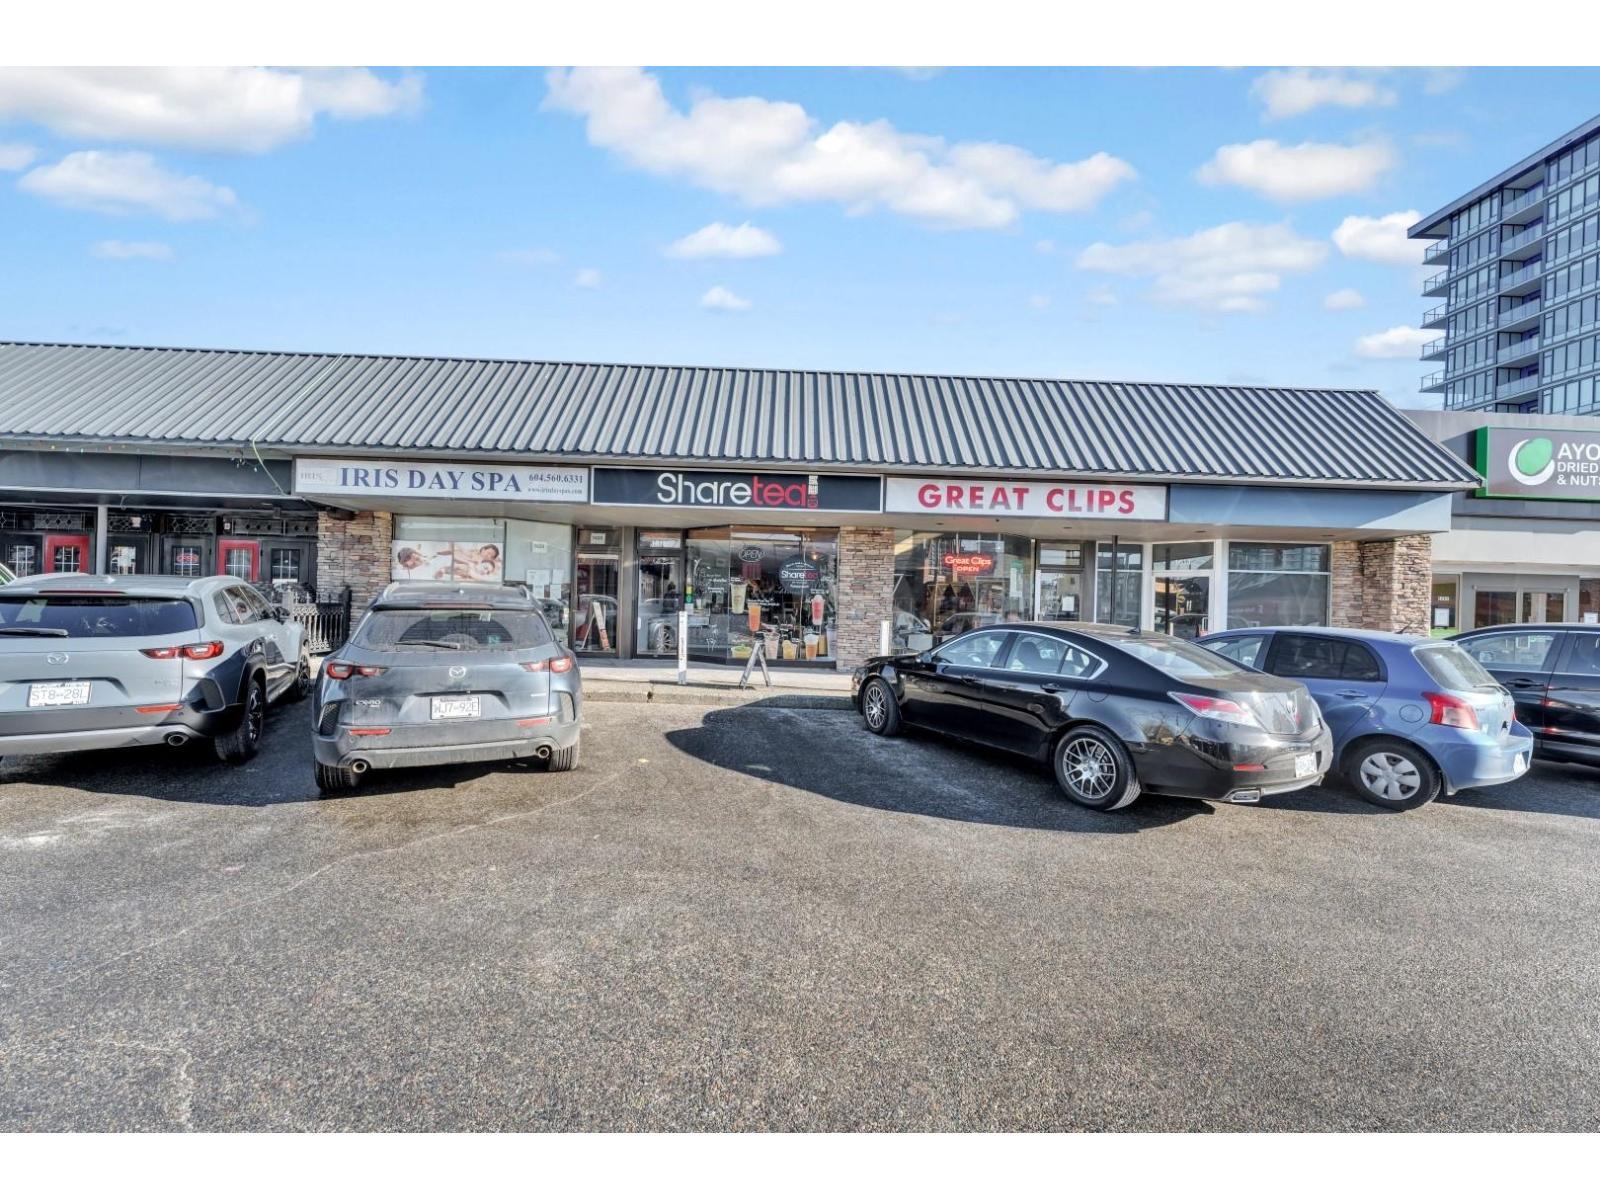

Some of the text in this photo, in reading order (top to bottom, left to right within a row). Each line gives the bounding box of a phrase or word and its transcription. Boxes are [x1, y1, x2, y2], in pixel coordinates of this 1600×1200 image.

[1557, 461, 1599, 473] DRIED
[340, 467, 522, 492] IRIS DAY SPA
[528, 473, 584, 484] 604.560.6331
[1557, 475, 1566, 485] &
[656, 472, 807, 508] Sharetea
[917, 483, 1135, 514] GREAT CLIPS
[944, 555, 992, 568] Great Clips
